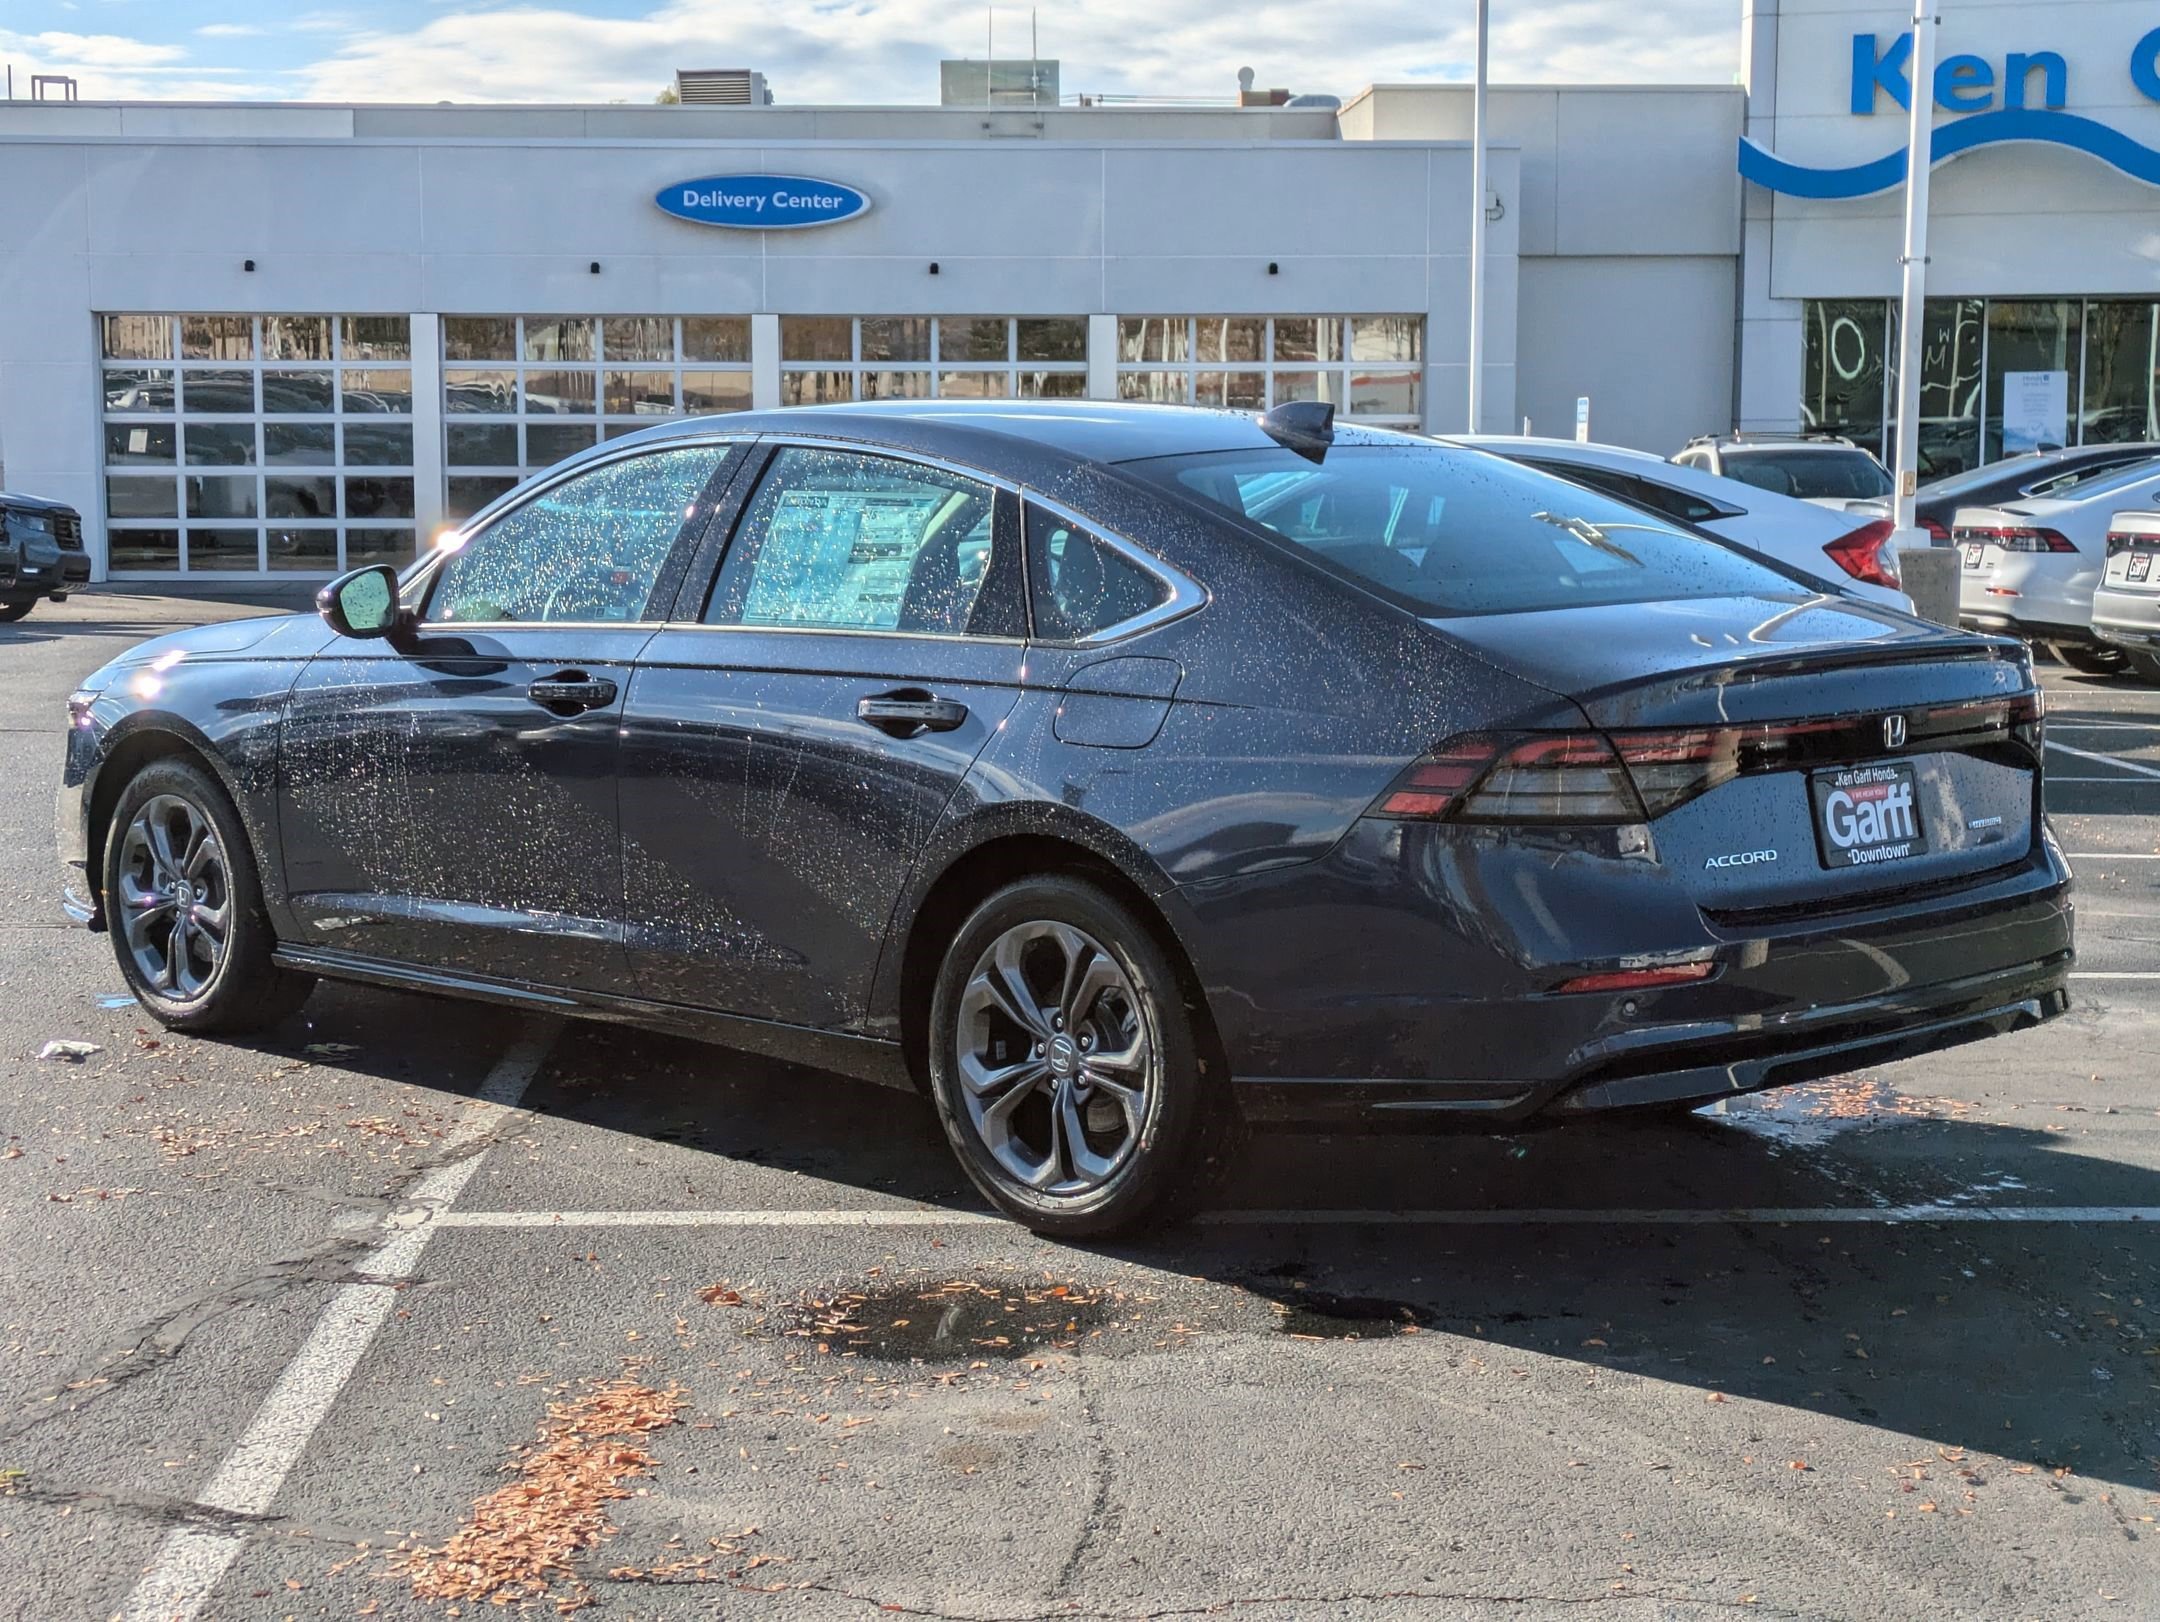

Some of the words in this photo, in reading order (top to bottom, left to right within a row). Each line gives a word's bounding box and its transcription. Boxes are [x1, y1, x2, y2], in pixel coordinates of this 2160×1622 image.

[1850, 32, 2067, 115] Ken
[683, 190, 766, 212] Delivery
[772, 191, 843, 209] Center
[1837, 771, 1853, 787] Ken
[1853, 767, 1871, 784] Garff
[1872, 766, 1895, 782] Honda
[1826, 782, 1913, 848] Garff
[1705, 849, 1777, 869] ACCORD
[1851, 845, 1909, 864] Downtown
